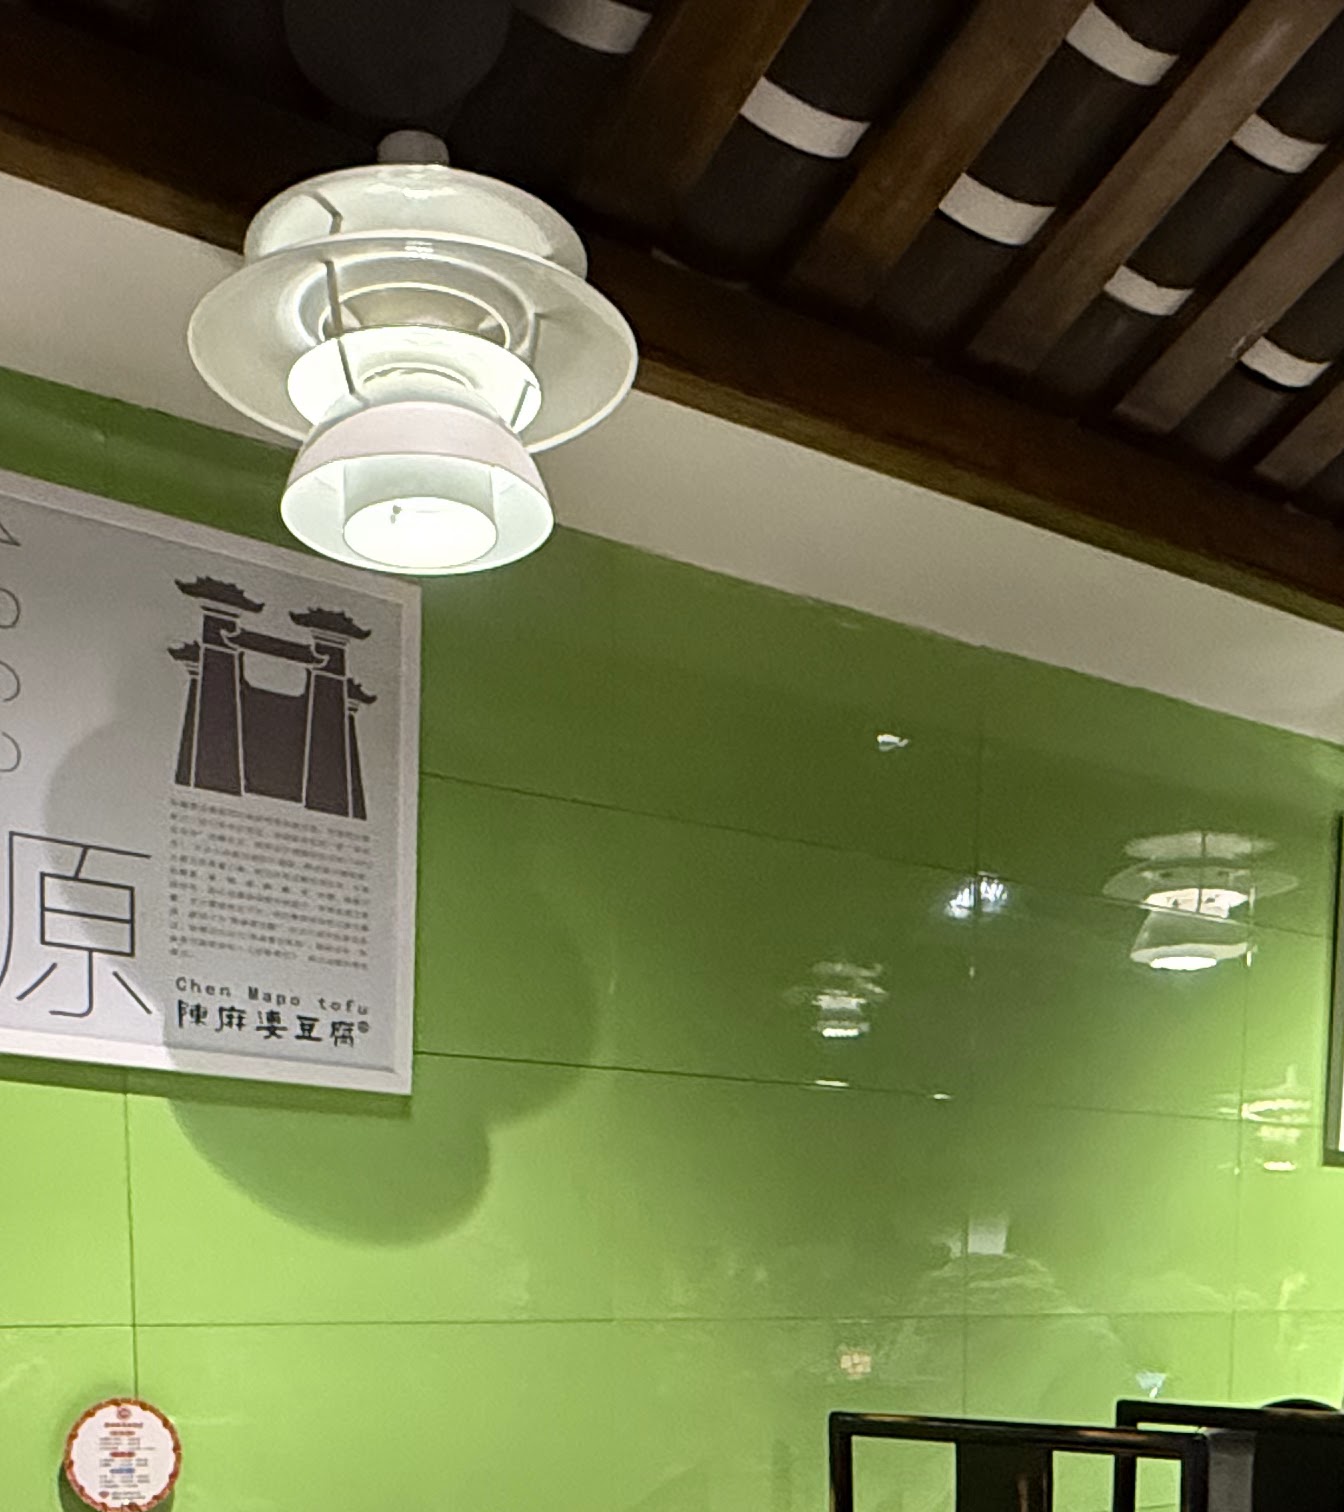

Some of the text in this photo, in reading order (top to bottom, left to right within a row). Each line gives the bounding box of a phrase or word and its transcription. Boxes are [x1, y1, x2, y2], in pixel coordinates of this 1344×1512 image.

[176, 976, 369, 1016] Chen Mapo tofu
